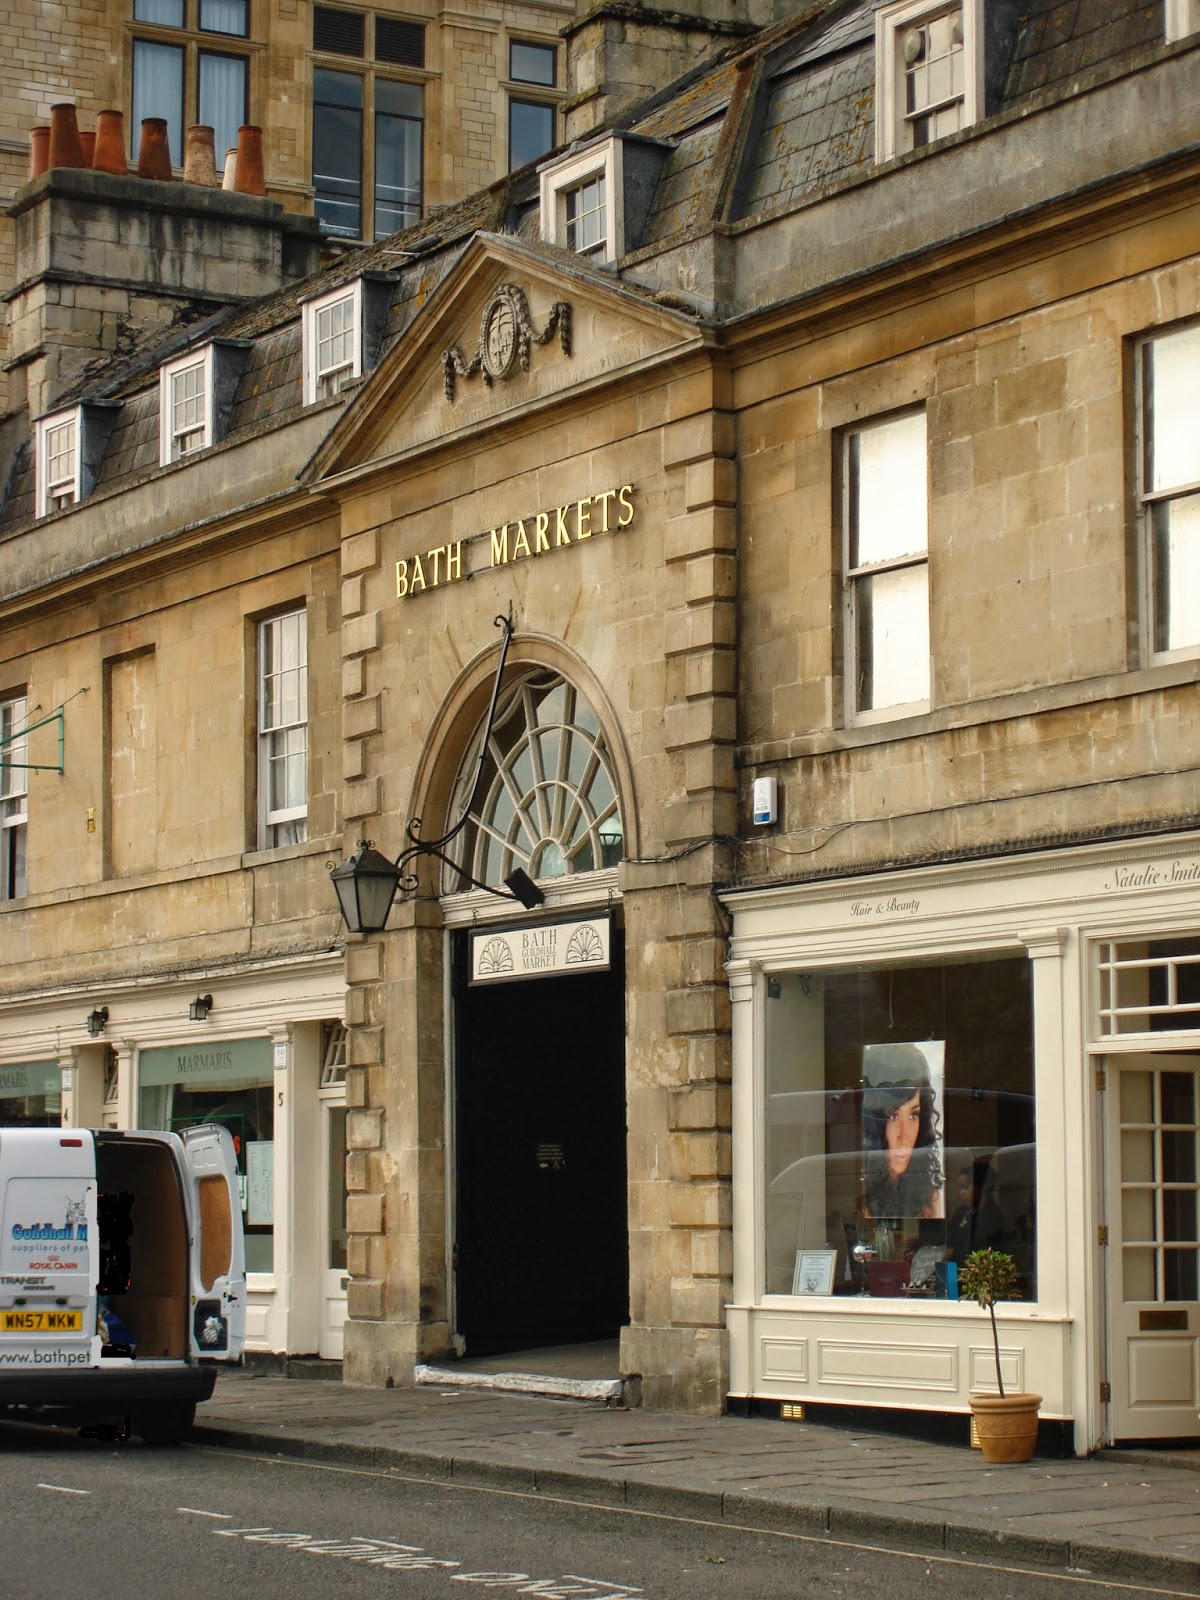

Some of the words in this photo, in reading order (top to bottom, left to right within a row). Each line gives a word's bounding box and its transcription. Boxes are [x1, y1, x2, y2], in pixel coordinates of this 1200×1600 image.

[395, 540, 462, 598] BATH
[490, 484, 635, 568] MARKETS
[1104, 864, 1160, 889] Natalie
[850, 901, 873, 917] Hair
[875, 902, 884, 914] &
[886, 897, 920, 914] Beauty
[522, 929, 557, 949] BATH
[522, 945, 557, 957] GUILDHALL
[522, 954, 557, 970] MARKET
[177, 1051, 232, 1073] MARMARIS
[278, 1092, 284, 1107] 5
[63, 1108, 69, 1122] 4
[12, 1223, 74, 1241] Guildhall
[12, 1243, 58, 1253] suppliers
[60, 1243, 71, 1252] of
[29, 1262, 52, 1270] ROYAL
[54, 1262, 78, 1270] CANIN
[6, 1313, 43, 1328] WN57
[48, 1313, 76, 1328] WKW
[211, 1527, 462, 1569] LOADING
